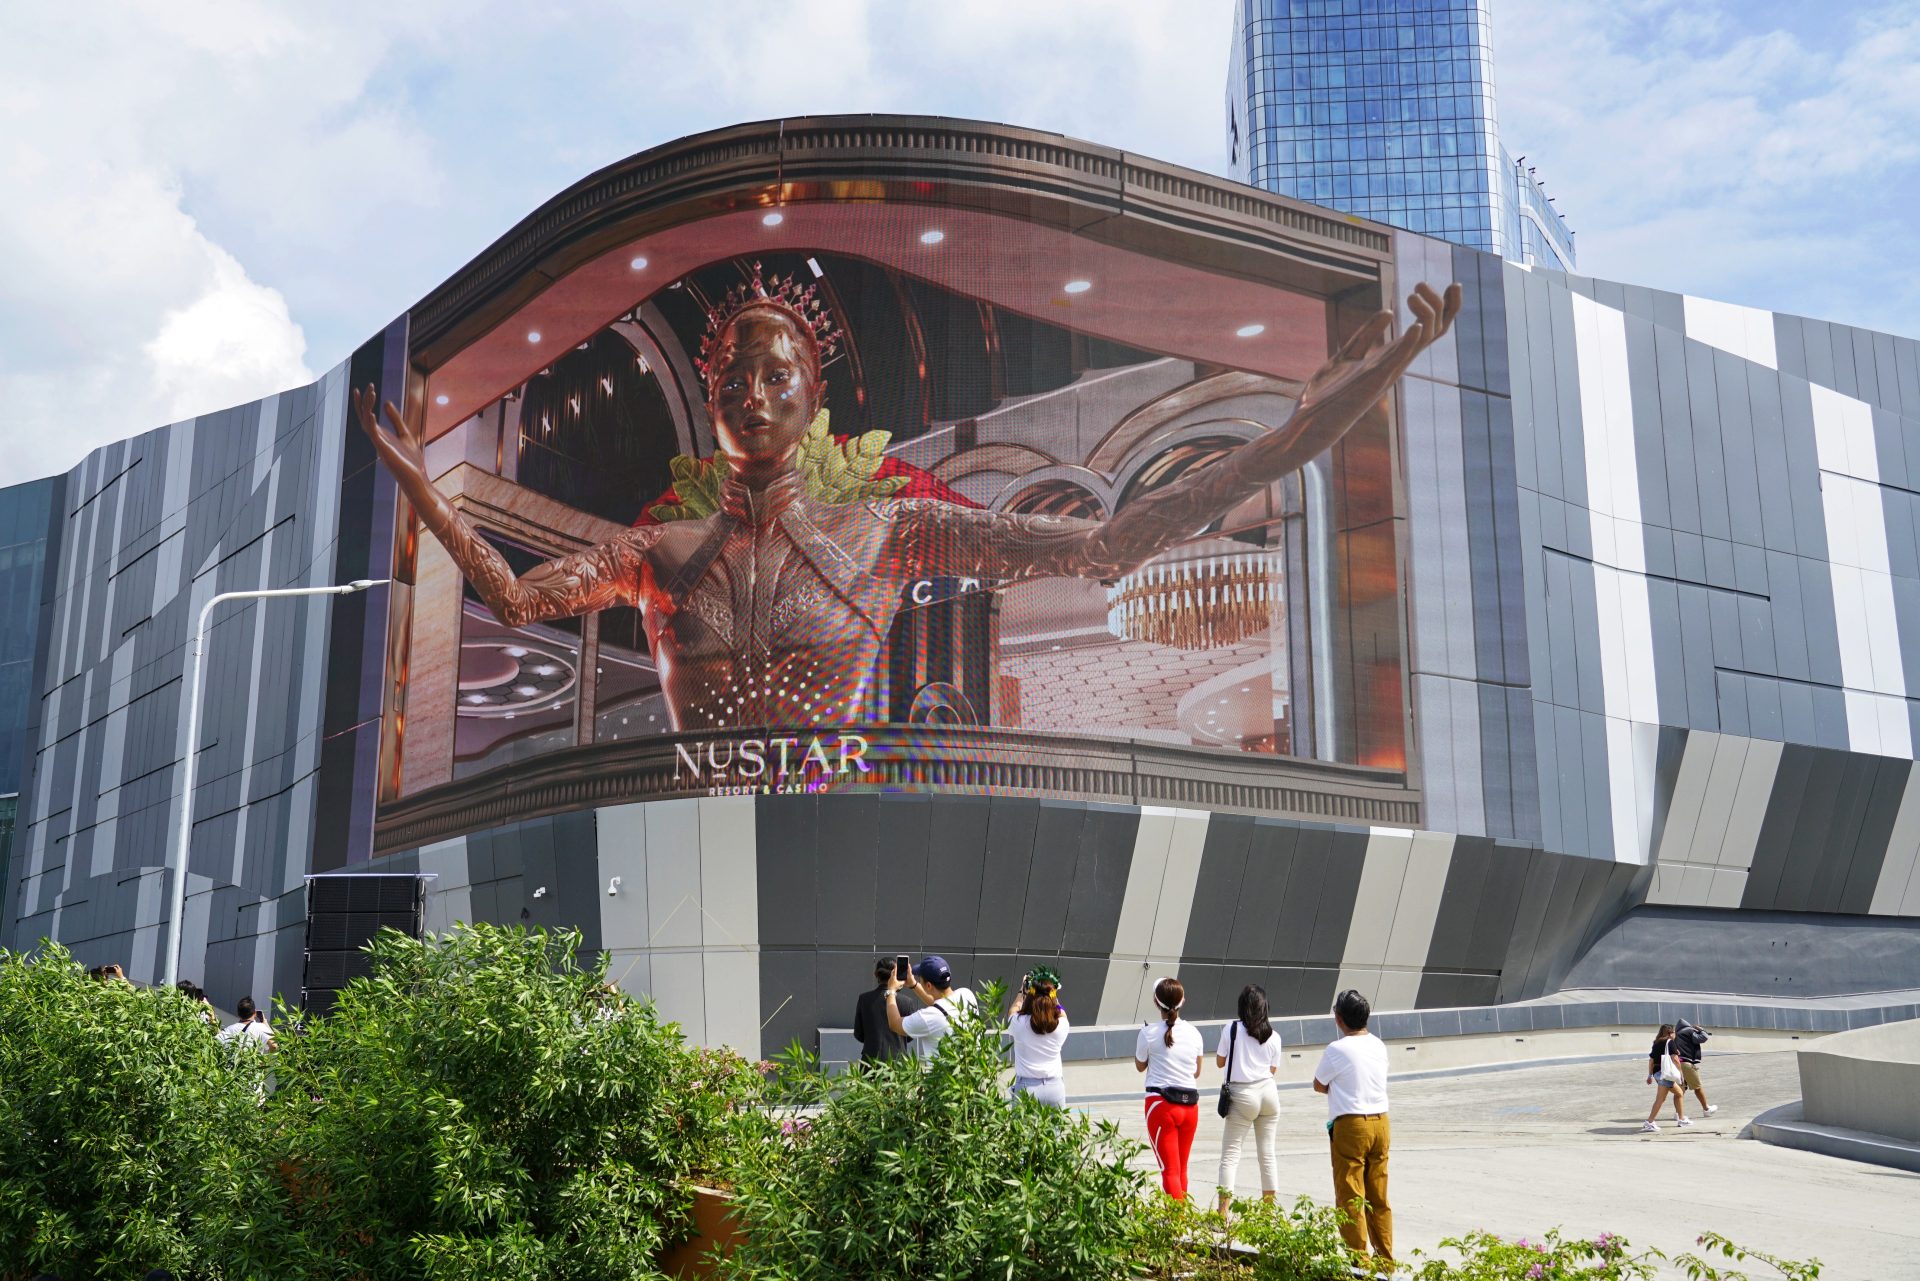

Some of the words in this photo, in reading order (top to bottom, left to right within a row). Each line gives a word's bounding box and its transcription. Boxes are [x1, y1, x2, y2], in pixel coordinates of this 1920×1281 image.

[673, 735, 870, 780] NUSTAR
[709, 786, 757, 797] RESORT
[763, 784, 770, 795] &
[776, 783, 828, 794] CASINO
